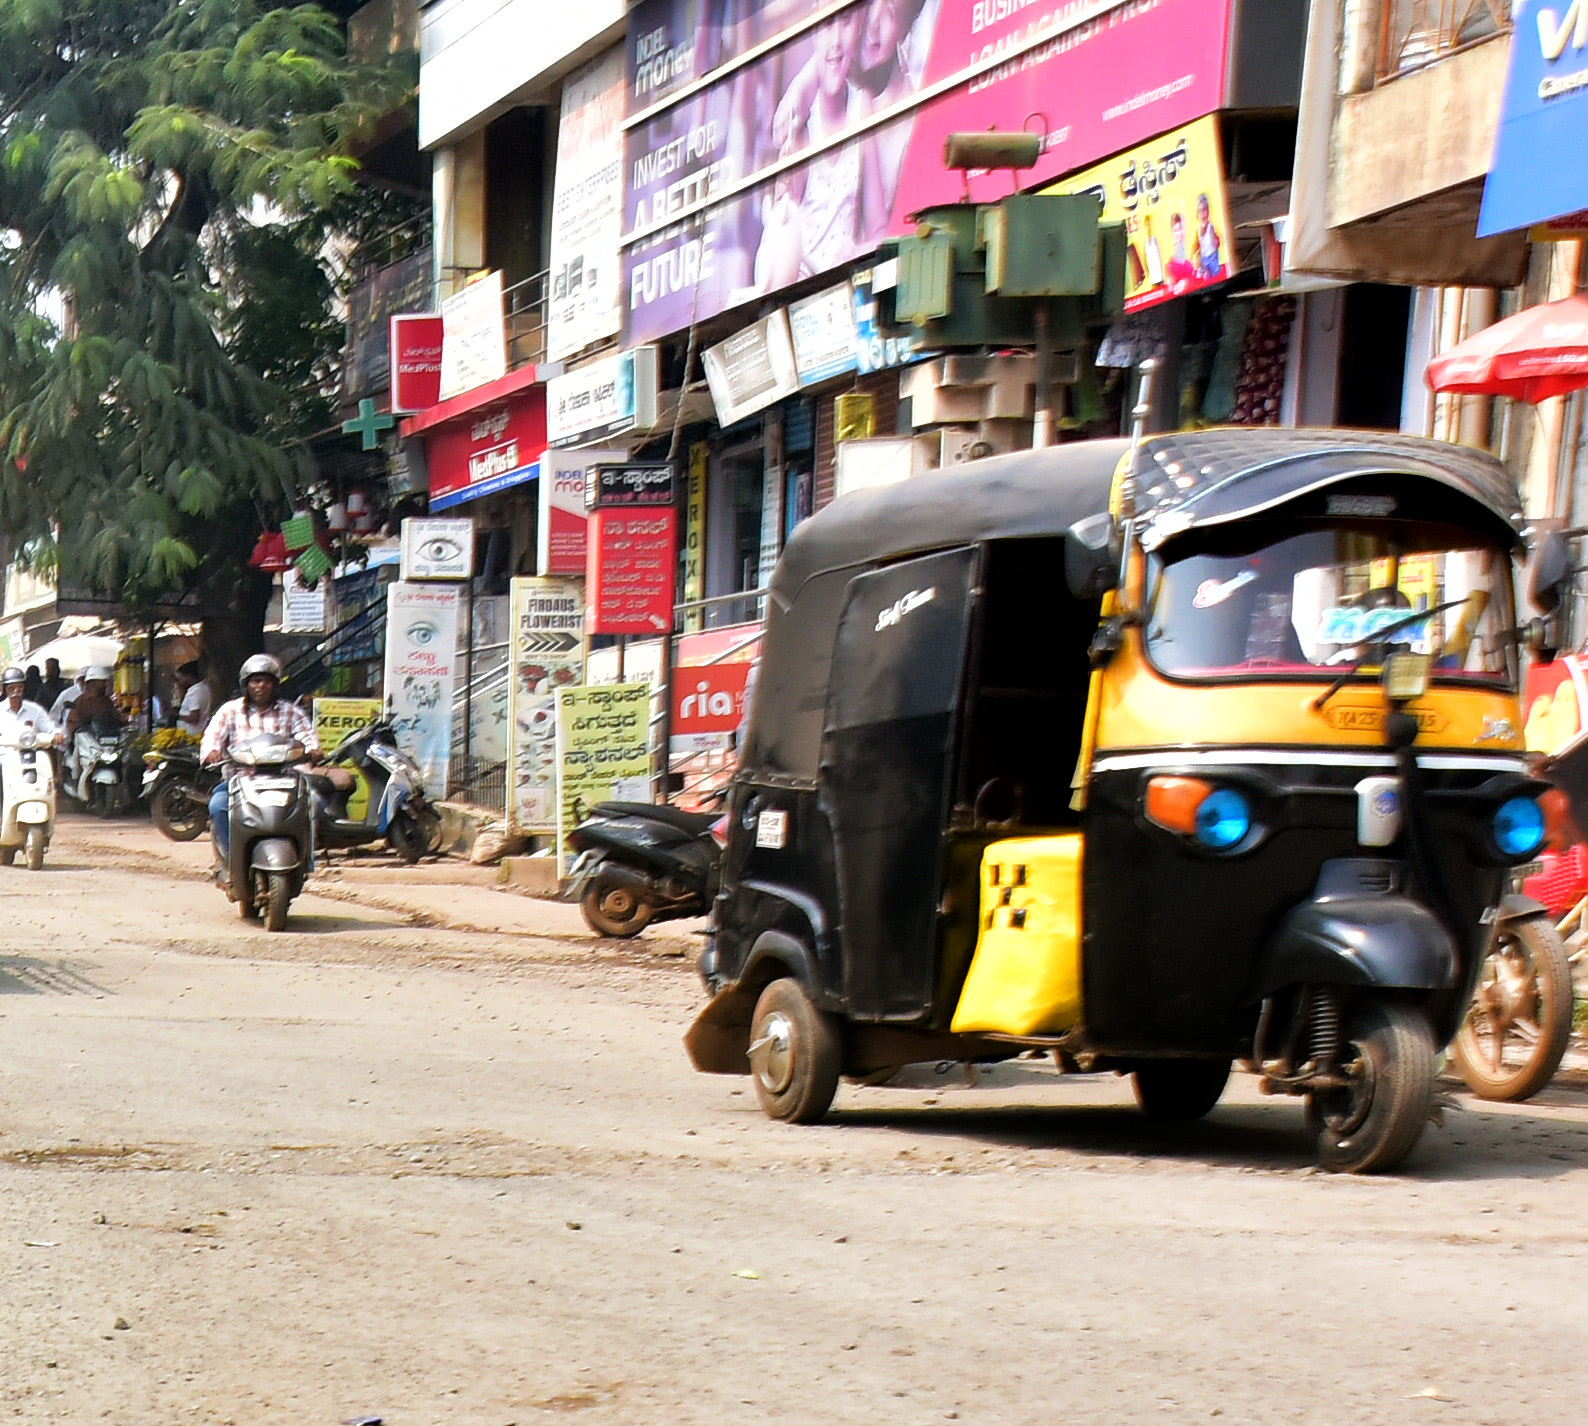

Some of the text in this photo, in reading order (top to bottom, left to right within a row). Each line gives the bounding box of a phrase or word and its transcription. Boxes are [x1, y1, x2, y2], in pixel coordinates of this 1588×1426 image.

[634, 120, 718, 191] INVEST FOR
[630, 232, 714, 311] FUTURE
[520, 614, 582, 629] FLOWERIST
[528, 598, 575, 613] FIRDAUS
[680, 680, 734, 719] ria
